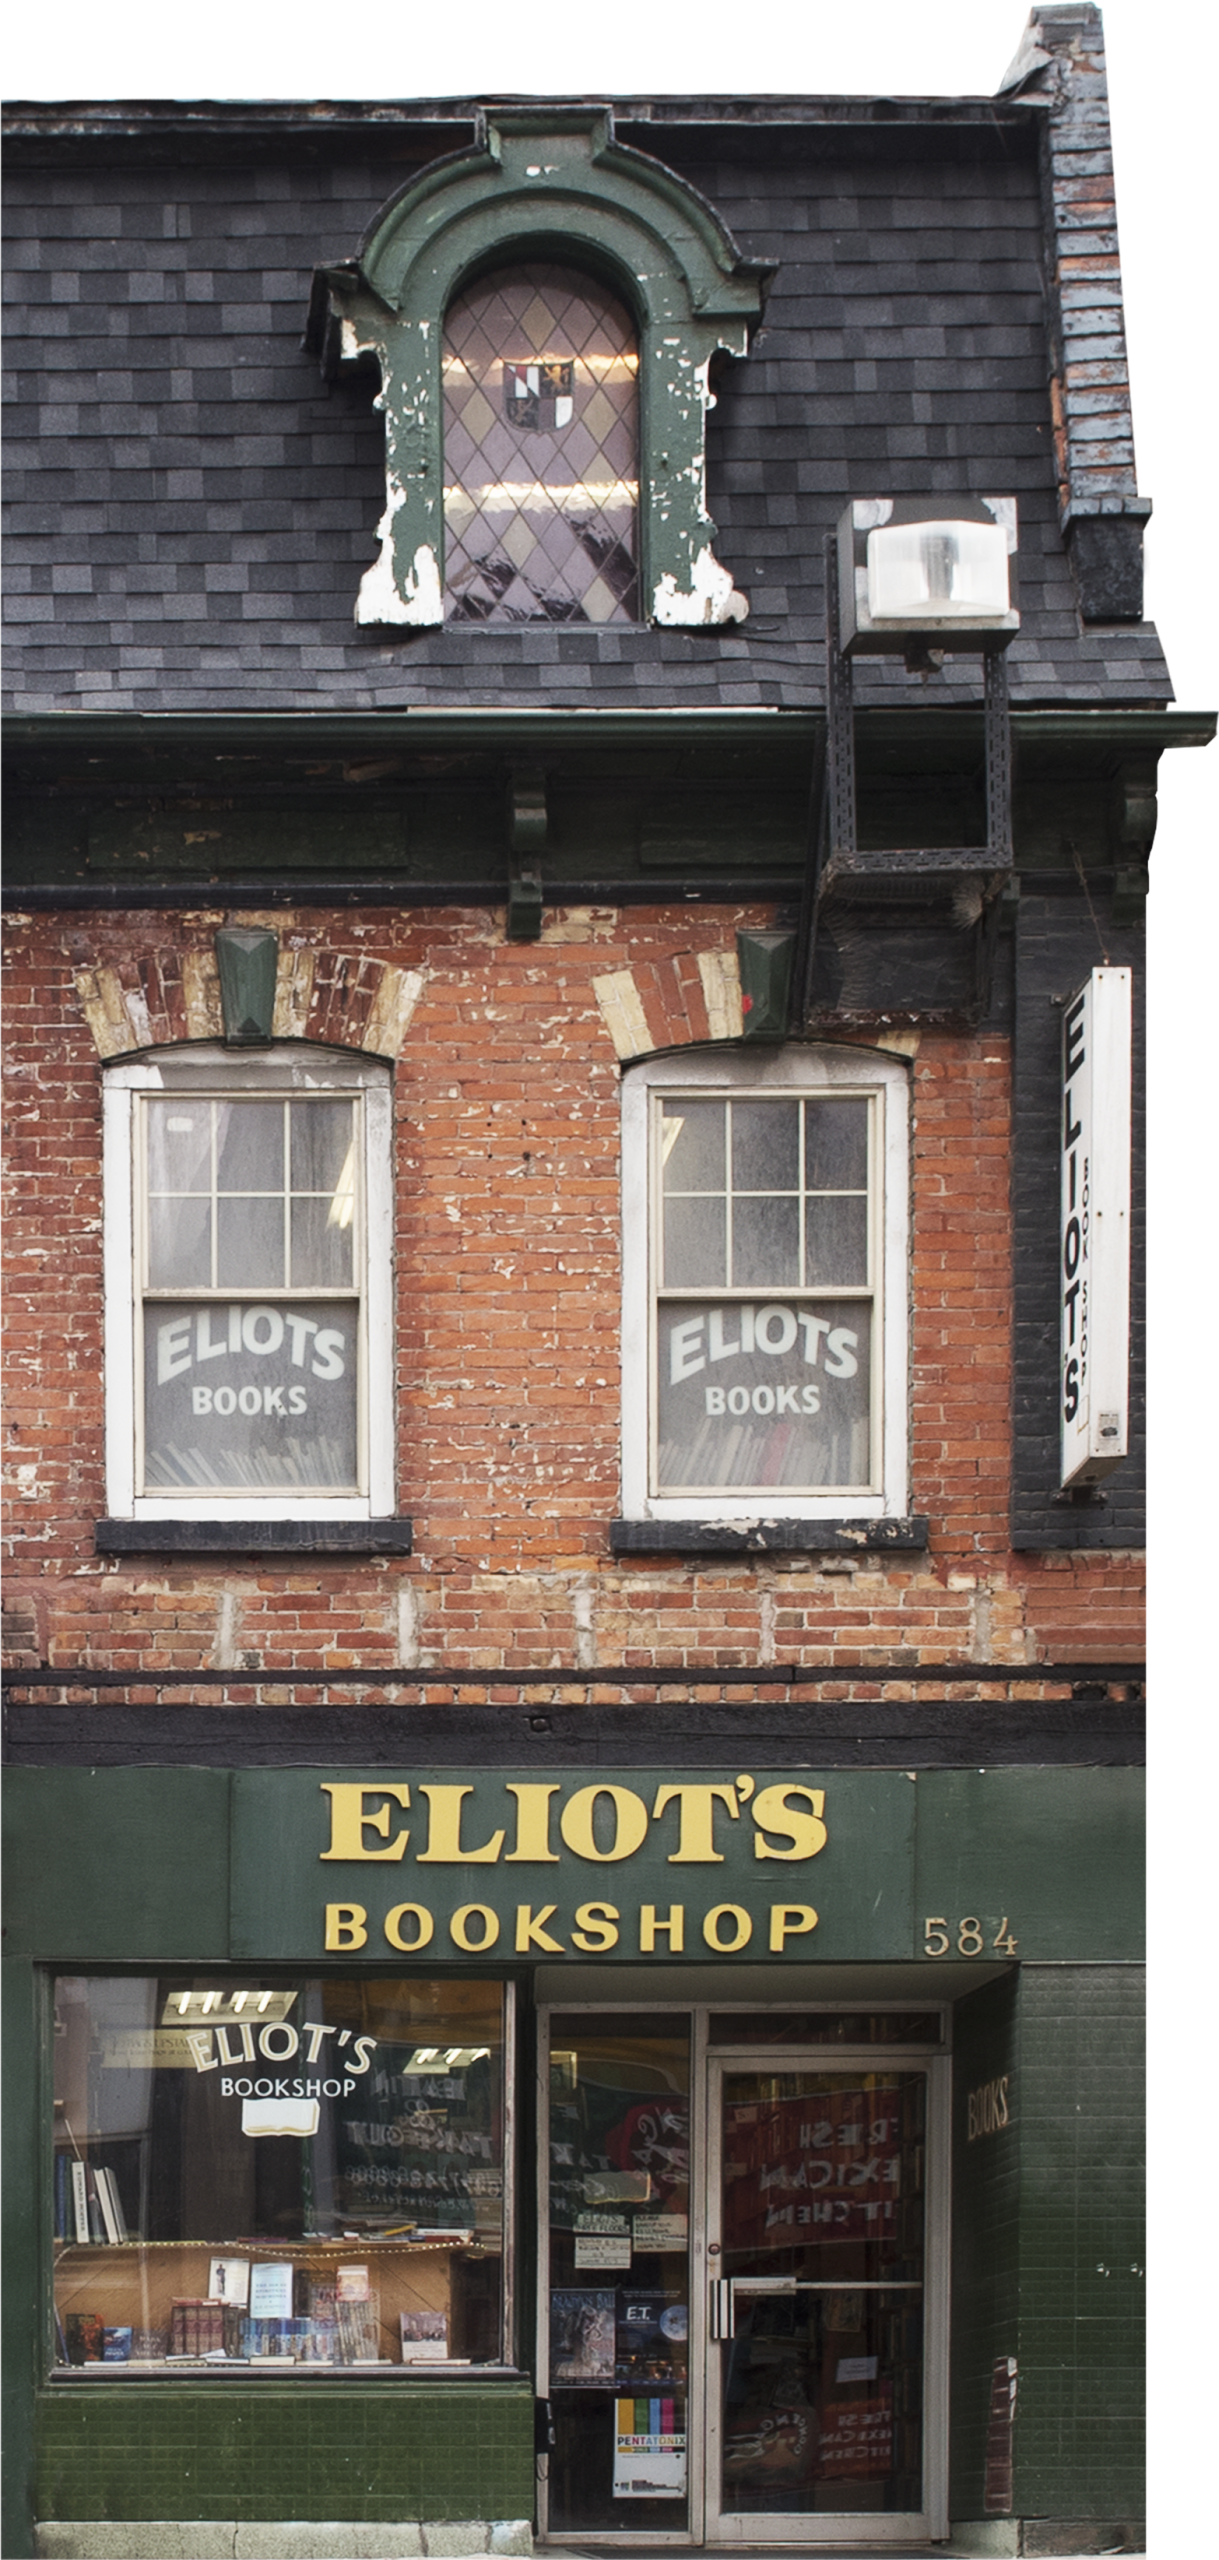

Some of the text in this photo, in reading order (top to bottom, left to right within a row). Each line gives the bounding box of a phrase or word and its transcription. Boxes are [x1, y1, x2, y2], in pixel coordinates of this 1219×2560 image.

[1063, 993, 1086, 1424] ELIOT'S
[1081, 1156, 1090, 1387] BOOK SHOP
[157, 1305, 346, 1387] ELIOTS
[670, 1304, 859, 1386] ELIOTS
[191, 1385, 309, 1416] BOOKS
[704, 1384, 821, 1416] BOOKS
[319, 1774, 829, 1863] ELIOT'S
[324, 1902, 819, 1953] BOOKSHOP
[923, 1916, 1019, 1957] 584
[185, 2021, 378, 2076] ELIOT'S
[220, 2076, 357, 2098] BOOKSHOP
[967, 2074, 1010, 2142] BOOKS
[626, 2306, 651, 2321] E.T.
[617, 2436, 686, 2446] PENTATONIX
